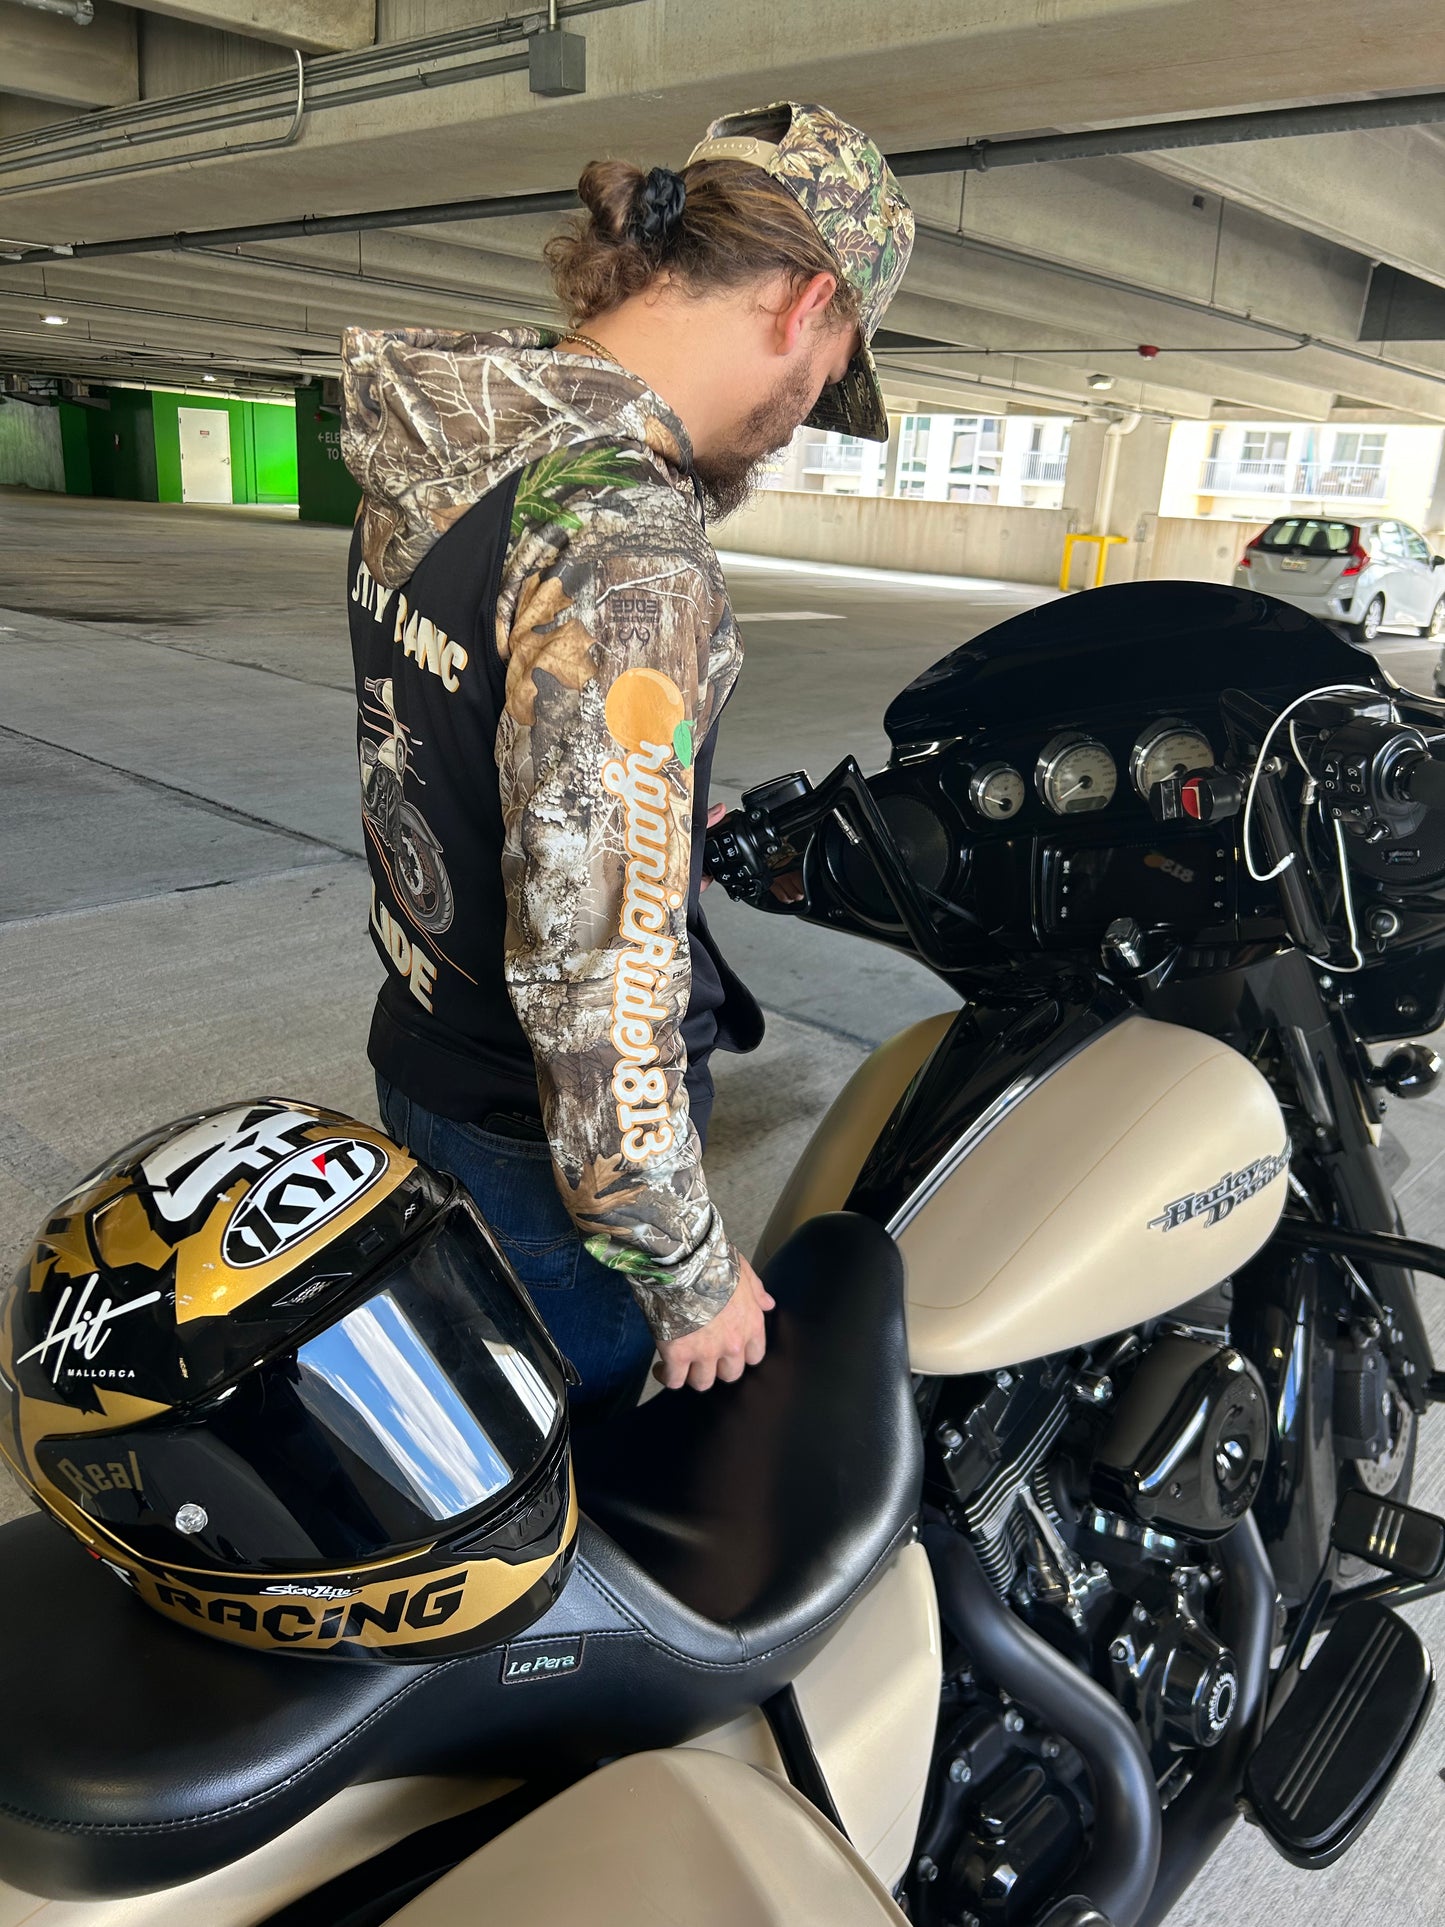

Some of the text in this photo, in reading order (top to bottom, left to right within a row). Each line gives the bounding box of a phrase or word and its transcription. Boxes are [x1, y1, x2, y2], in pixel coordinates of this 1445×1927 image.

[222, 1139, 364, 1261] KYT
[16, 1272, 162, 1385] Hit
[66, 1368, 136, 1378] MALLORCA
[56, 1449, 145, 1500] Real
[507, 1655, 575, 1678] Le Pera
